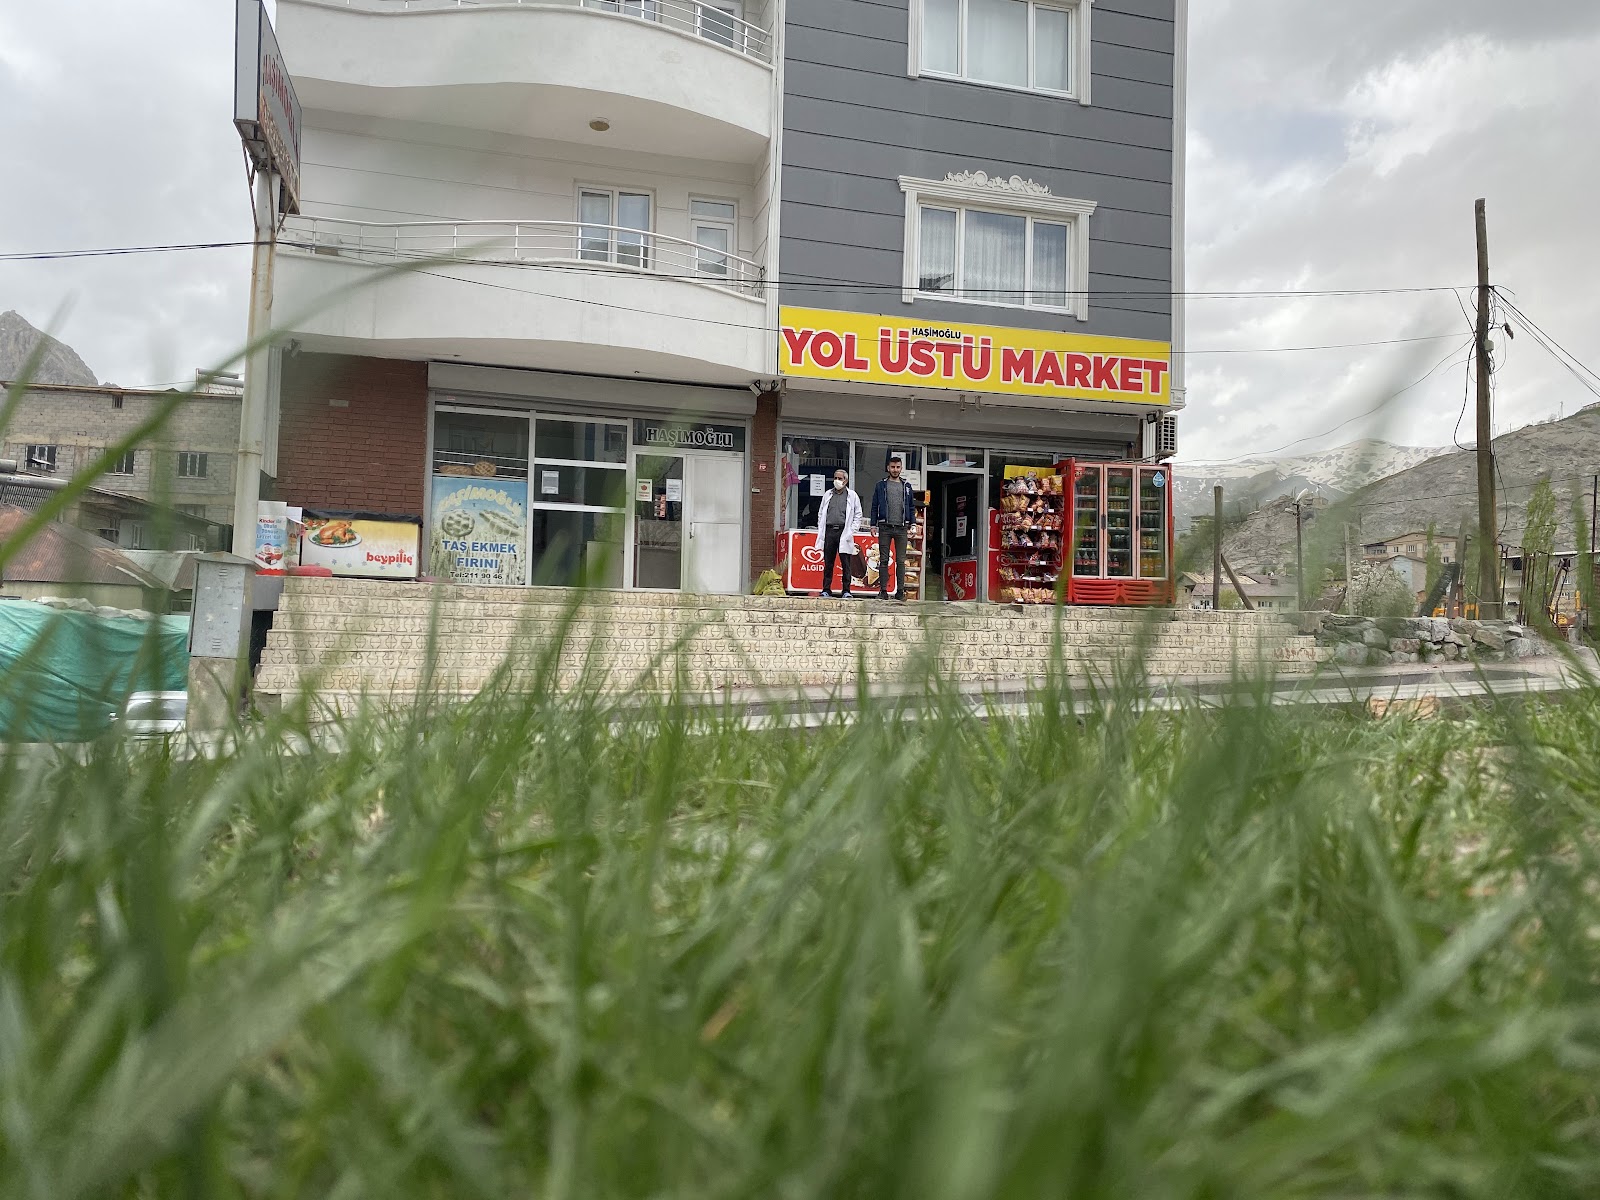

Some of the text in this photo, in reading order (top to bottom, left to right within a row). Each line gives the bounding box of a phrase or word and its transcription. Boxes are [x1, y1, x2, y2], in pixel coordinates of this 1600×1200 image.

[911, 327, 962, 340] HAŞİMOĞLU
[782, 328, 1168, 394] YOL ÜSTÜ MARKET
[646, 427, 733, 447] HAŞİMOĞLU
[442, 540, 516, 554] TAŞ EKMEK
[456, 557, 498, 569] FIRINI
[800, 564, 825, 572] ALGID
